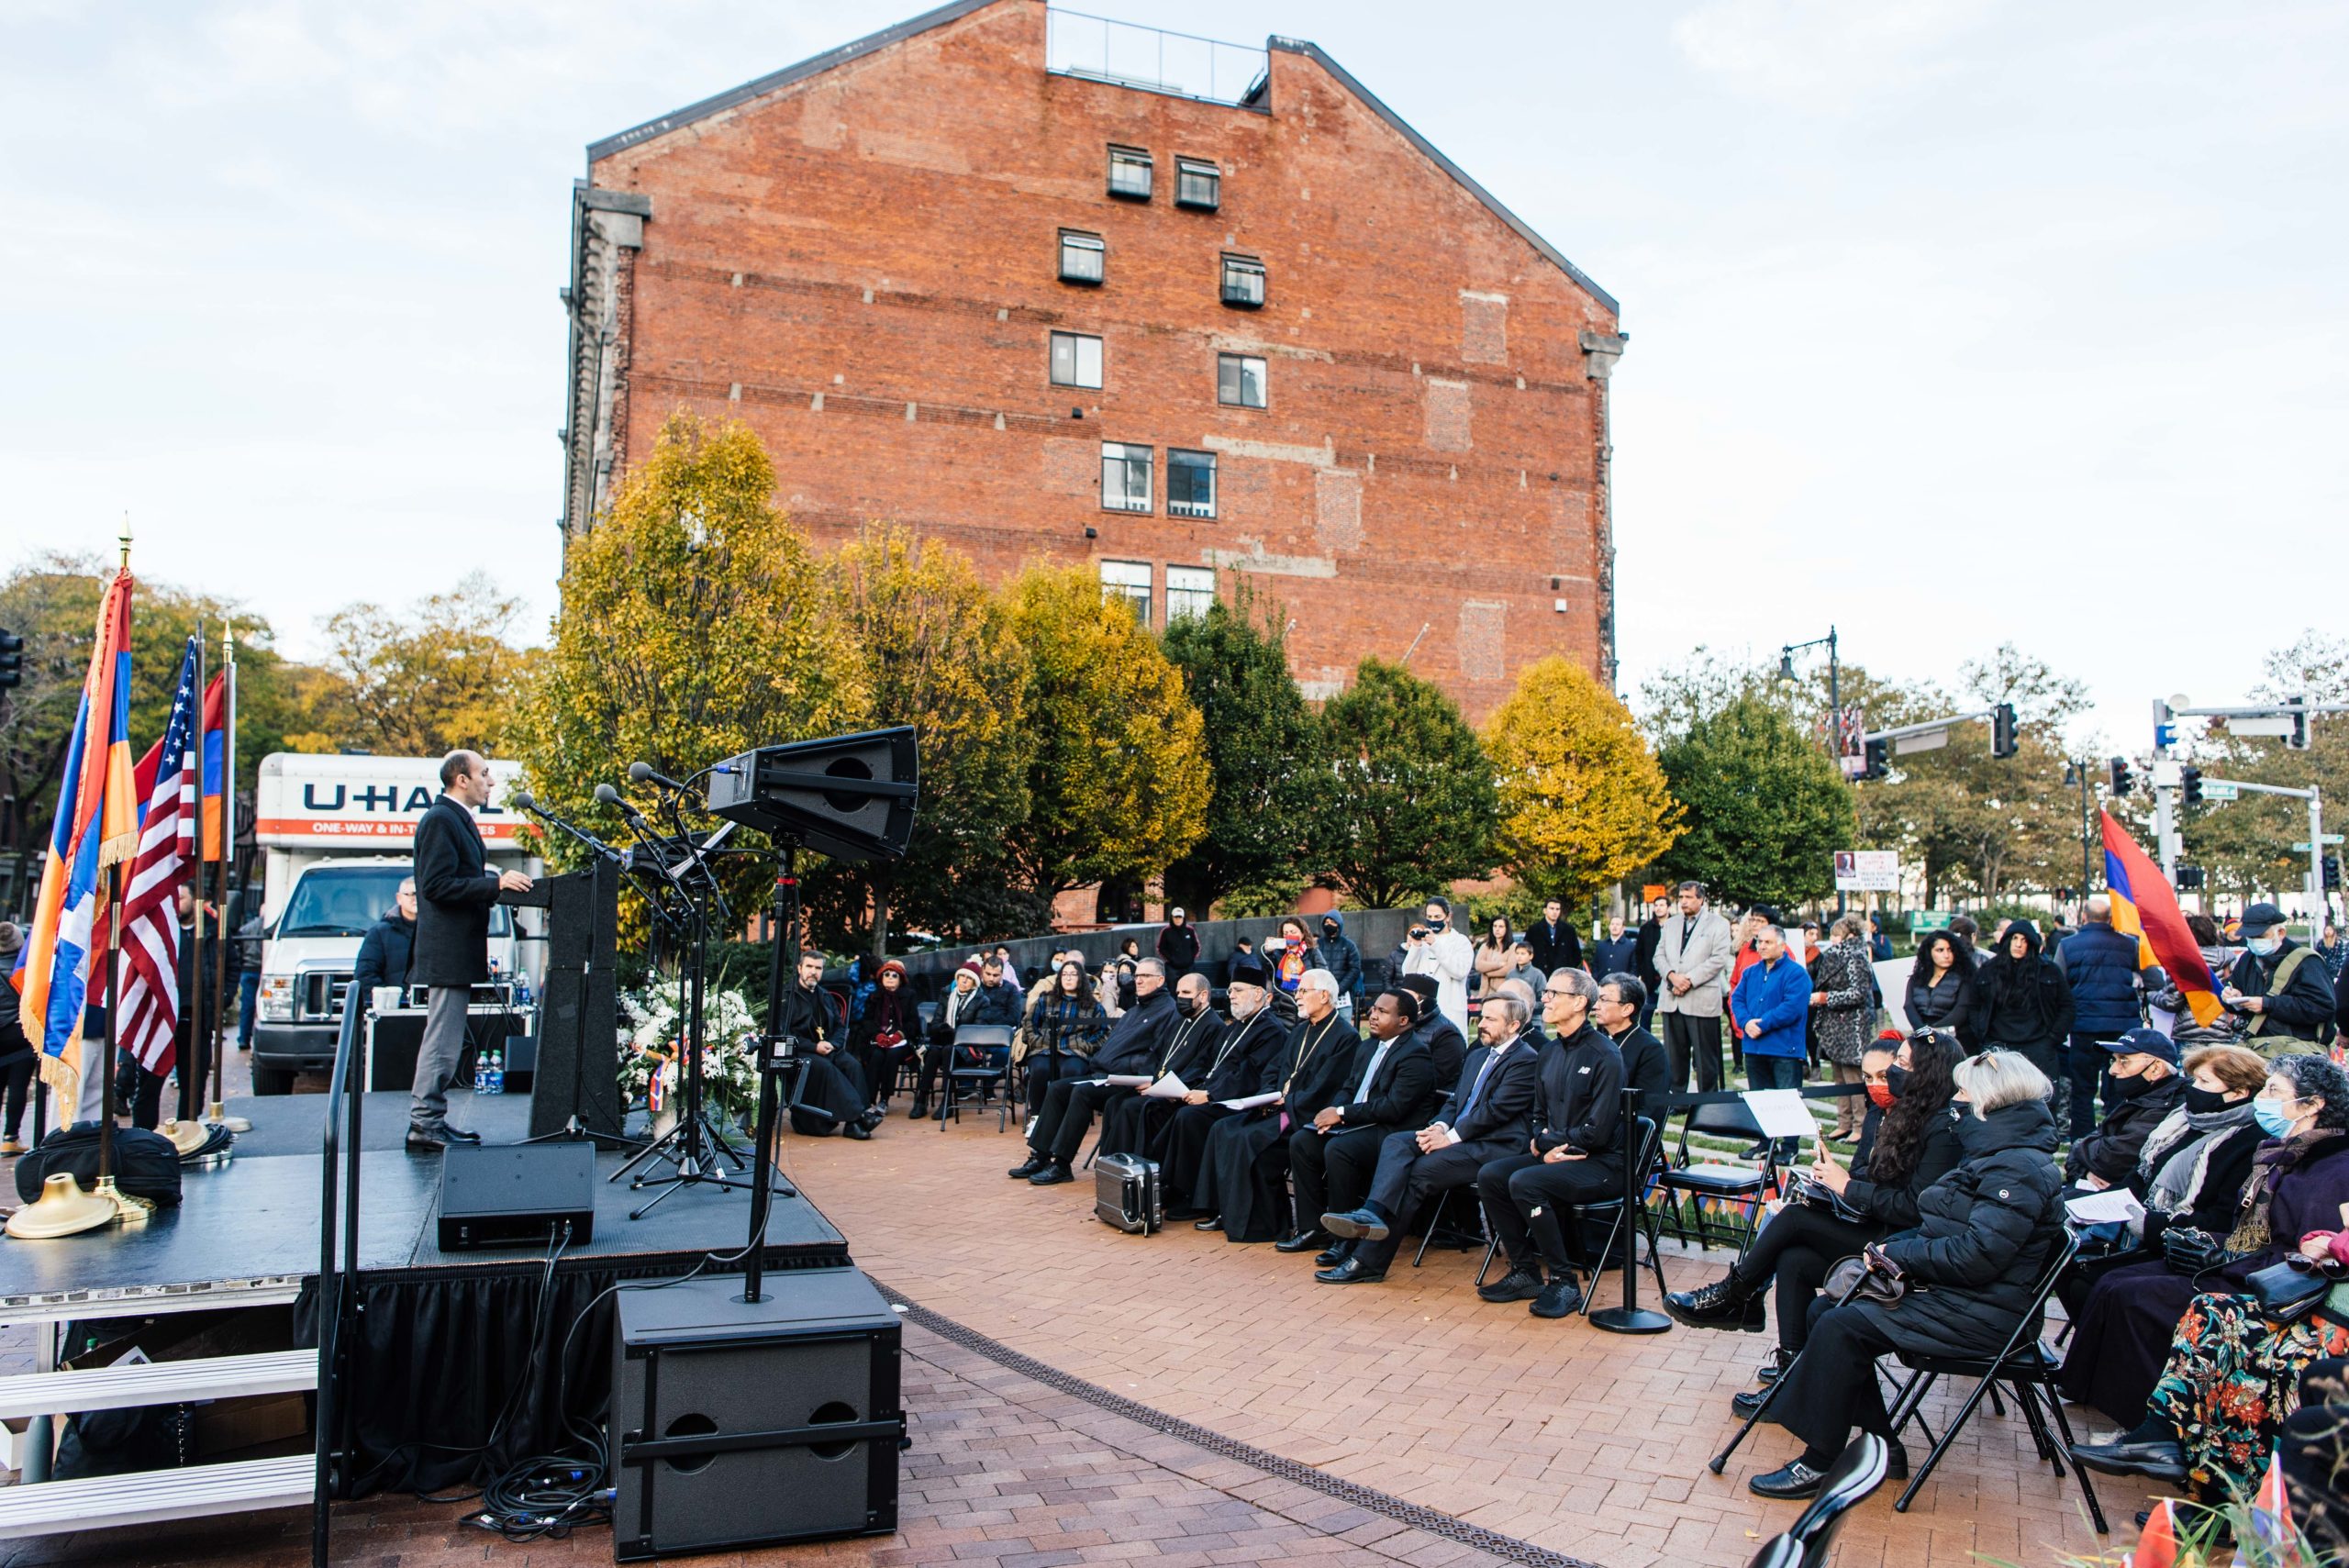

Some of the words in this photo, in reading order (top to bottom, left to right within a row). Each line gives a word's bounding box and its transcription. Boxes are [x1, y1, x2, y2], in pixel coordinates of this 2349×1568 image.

[304, 784, 504, 815] U-HAL
[313, 822, 374, 834] ONE-WAY
[377, 823, 388, 834] &
[390, 823, 417, 835] IN-T
